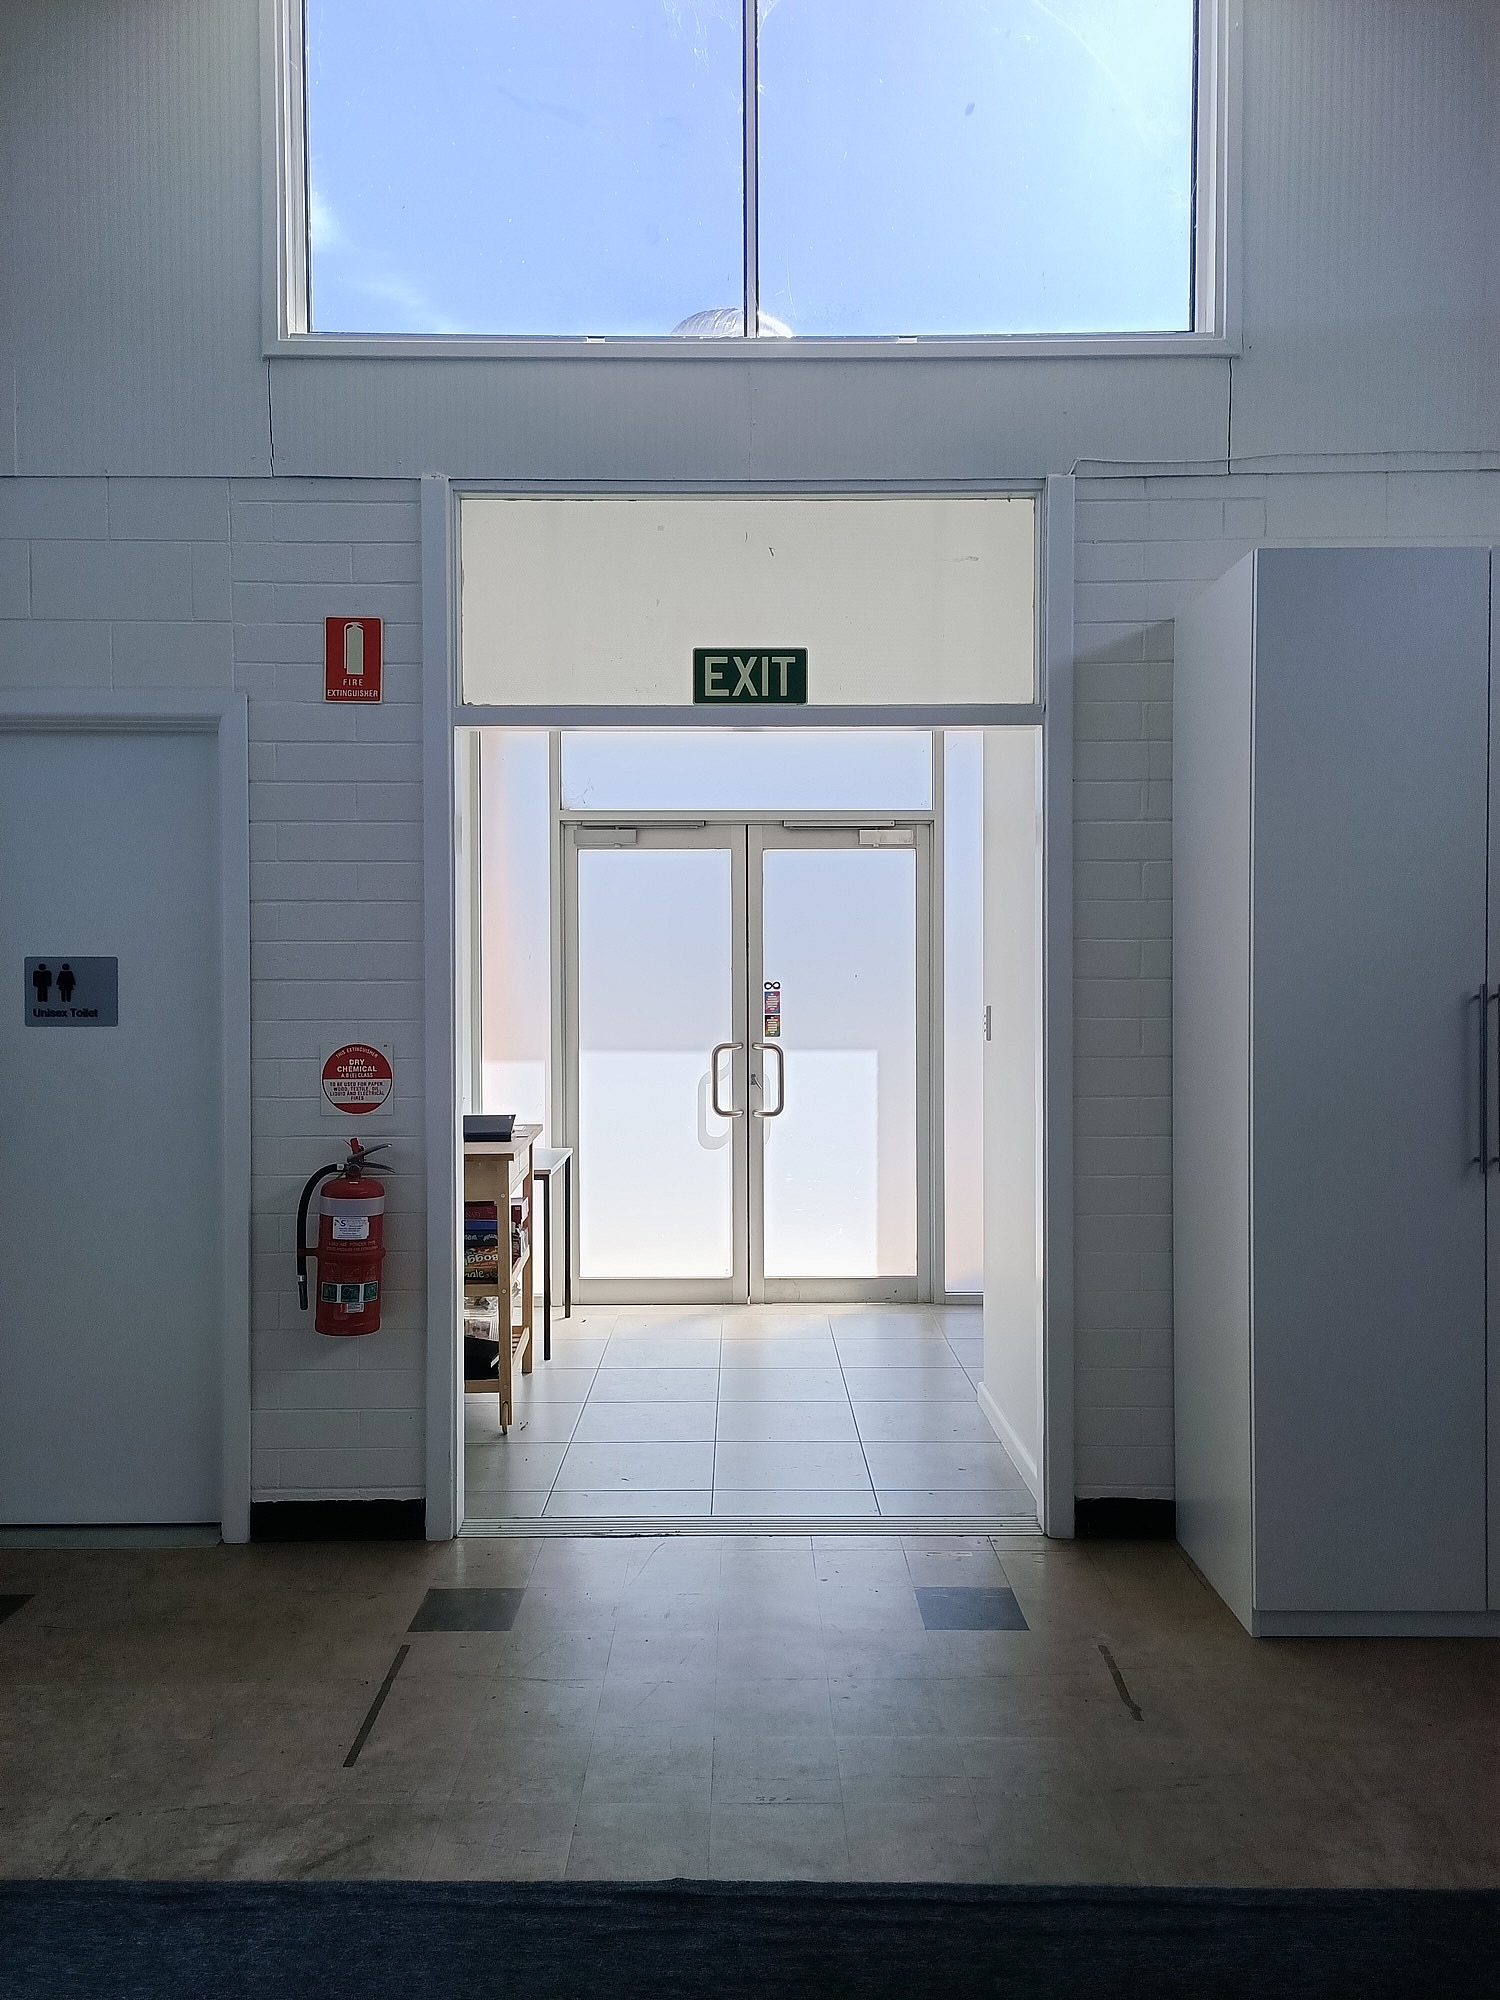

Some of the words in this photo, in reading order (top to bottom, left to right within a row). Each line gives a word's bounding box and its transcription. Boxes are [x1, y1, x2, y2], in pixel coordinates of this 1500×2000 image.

[704, 656, 796, 697] EXIT
[342, 678, 364, 687] FIRE
[327, 689, 379, 697] EXTINGUISHER
[32, 1008, 68, 1018] Unisex
[69, 1008, 98, 1018] Toilet
[346, 1046, 379, 1059] EXTINGUISHER
[348, 1058, 366, 1066] DRY
[336, 1065, 378, 1073] CHEMICAL
